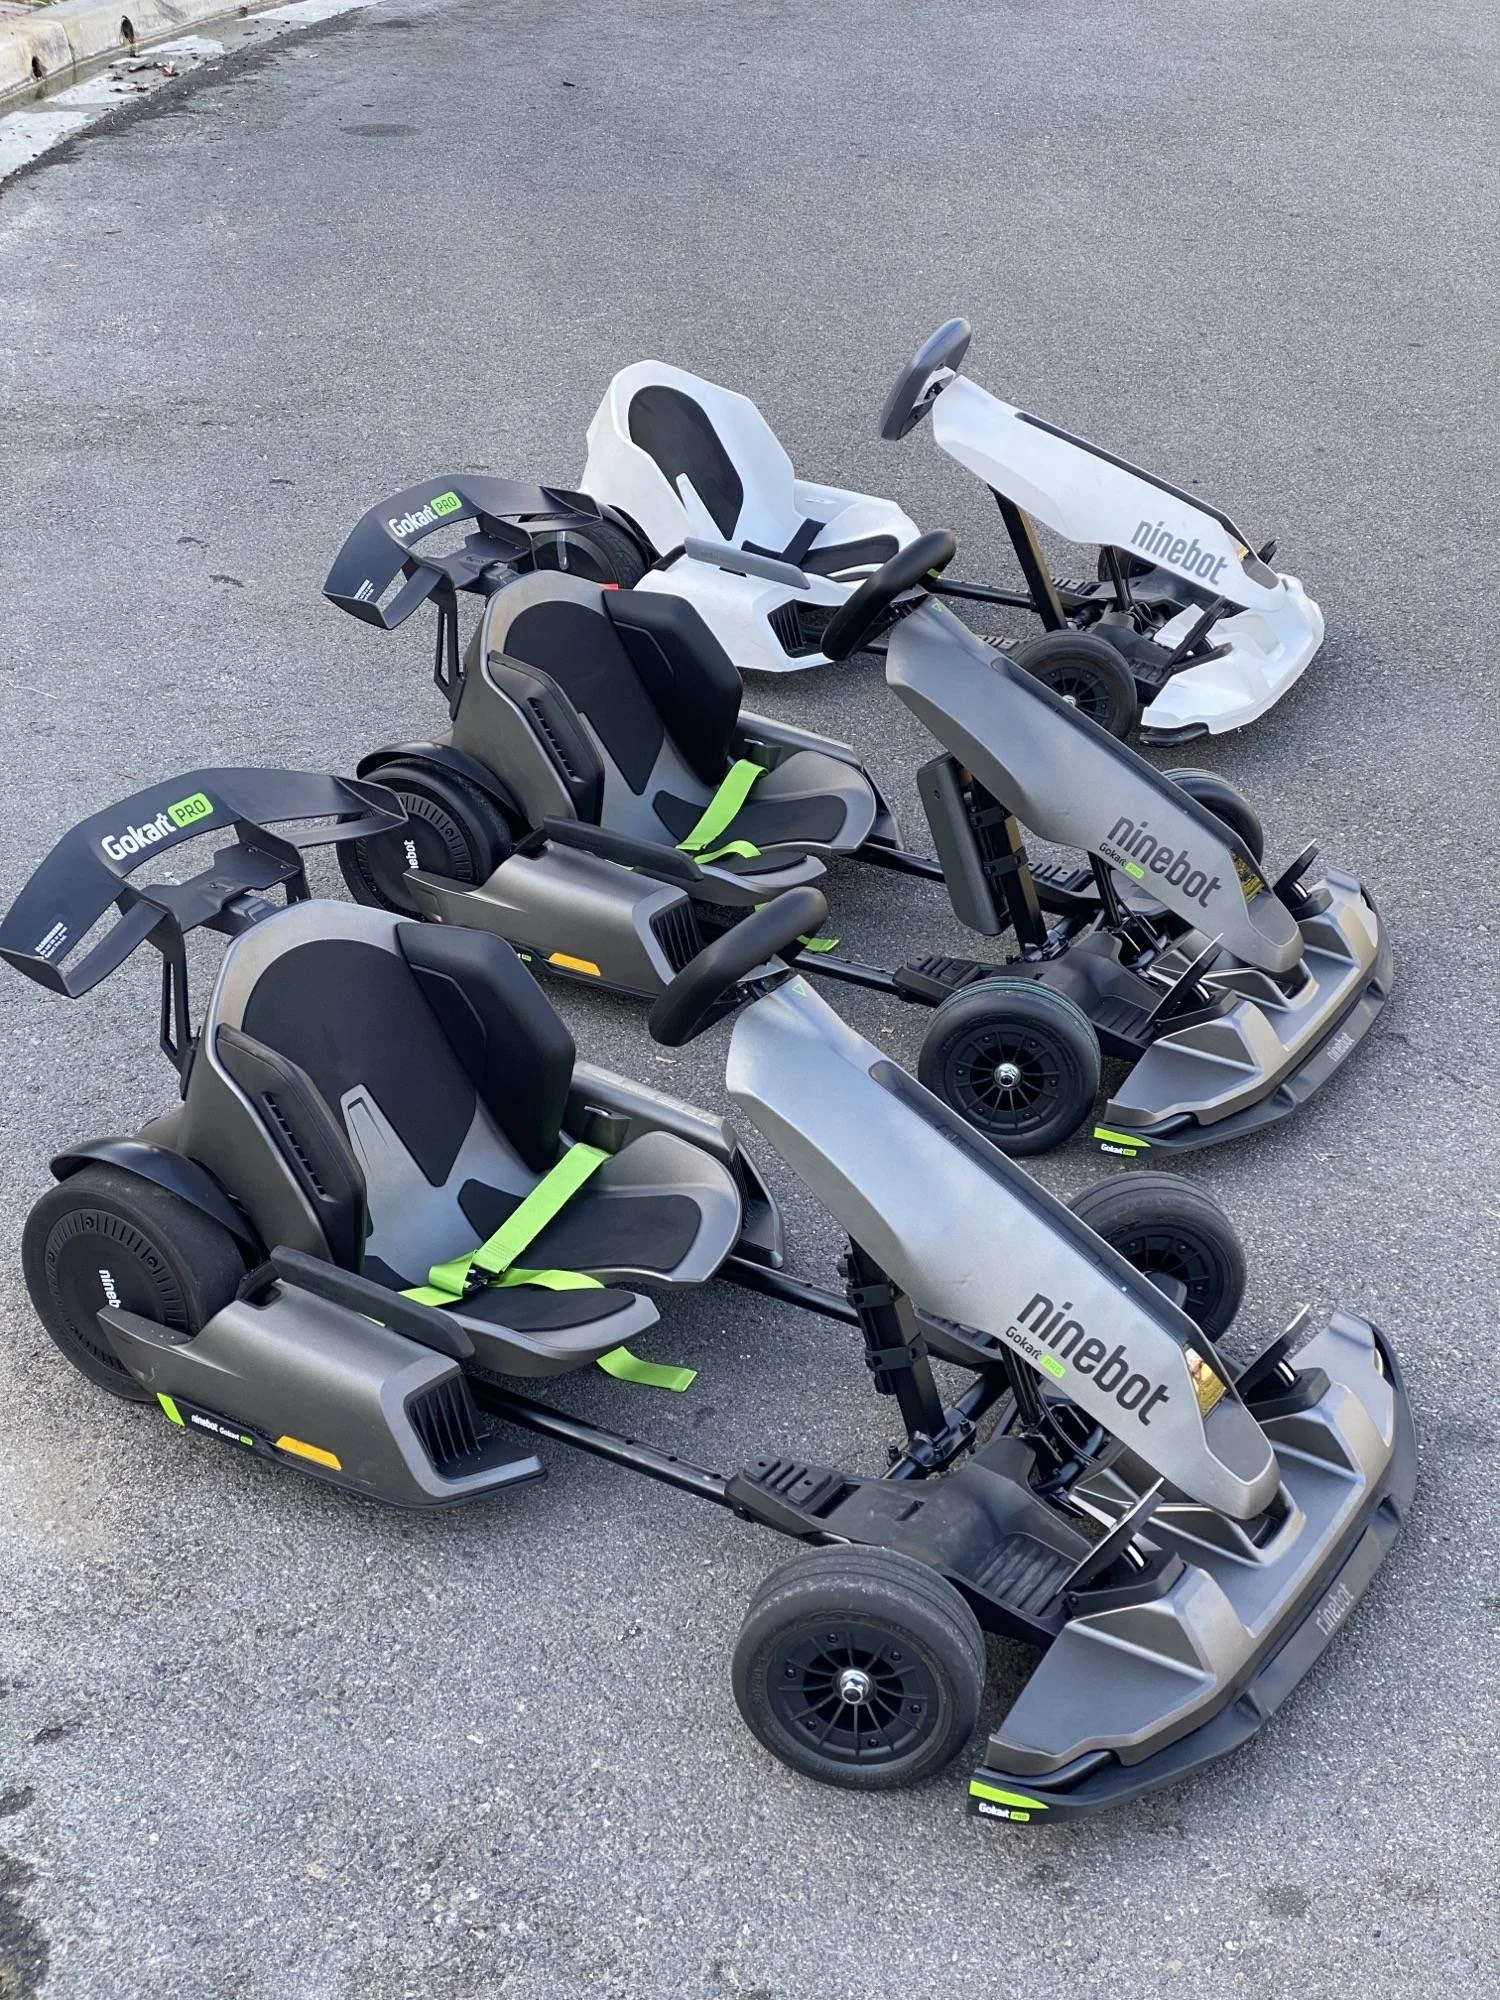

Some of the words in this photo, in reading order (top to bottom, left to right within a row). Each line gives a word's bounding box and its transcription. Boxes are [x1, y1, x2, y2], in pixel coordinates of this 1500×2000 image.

[389, 504, 438, 537] Gokart
[435, 495, 458, 513] PRO
[1130, 519, 1228, 586] ninebot
[101, 812, 176, 860] Gokart
[173, 798, 208, 824] PRO
[1098, 842, 1127, 866] Gokart
[1107, 815, 1221, 908] ninebot
[98, 1269, 121, 1309] nineb
[1005, 1325, 1042, 1360] Gokart
[1016, 1292, 1170, 1426] ninebot
[978, 1802, 1010, 1819] Gokart
